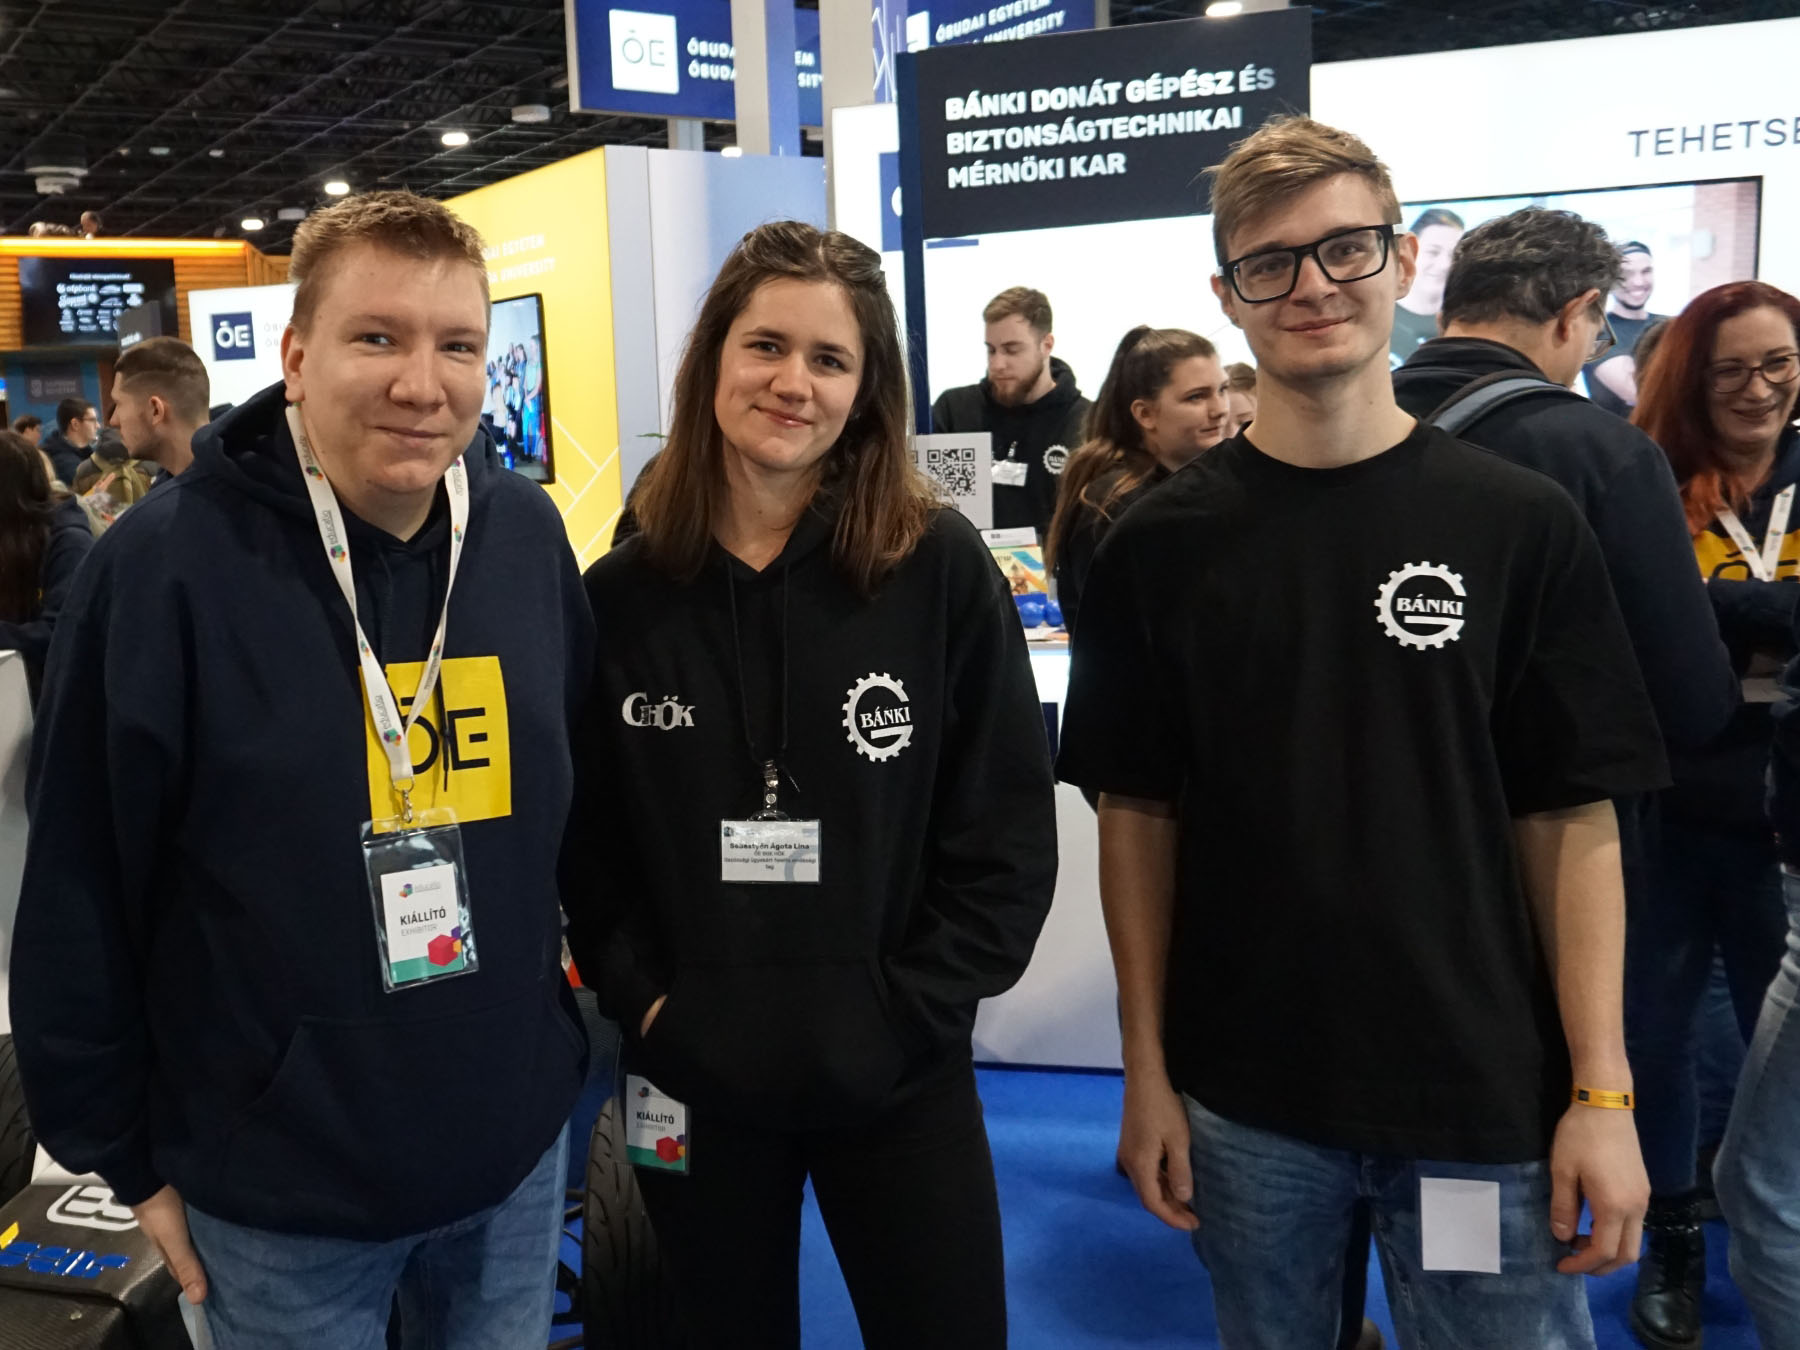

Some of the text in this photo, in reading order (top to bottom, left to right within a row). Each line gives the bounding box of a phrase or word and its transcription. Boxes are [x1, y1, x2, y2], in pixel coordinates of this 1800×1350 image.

[935, 13, 987, 43] ÓBUDAI
[945, 64, 1276, 121] BÁNKI DONÁT GÉPÉSZ ÉS
[946, 106, 1243, 154] BIZTONSÁGTECHNIKAI
[947, 152, 1127, 189] MÉRNÖKI KAR
[1396, 593, 1464, 616] BÁNKI
[859, 705, 911, 728] BÁNKI
[400, 906, 446, 925] KIÁLLÍTÓ
[636, 1111, 674, 1124] KIÁLLÍTÓ
